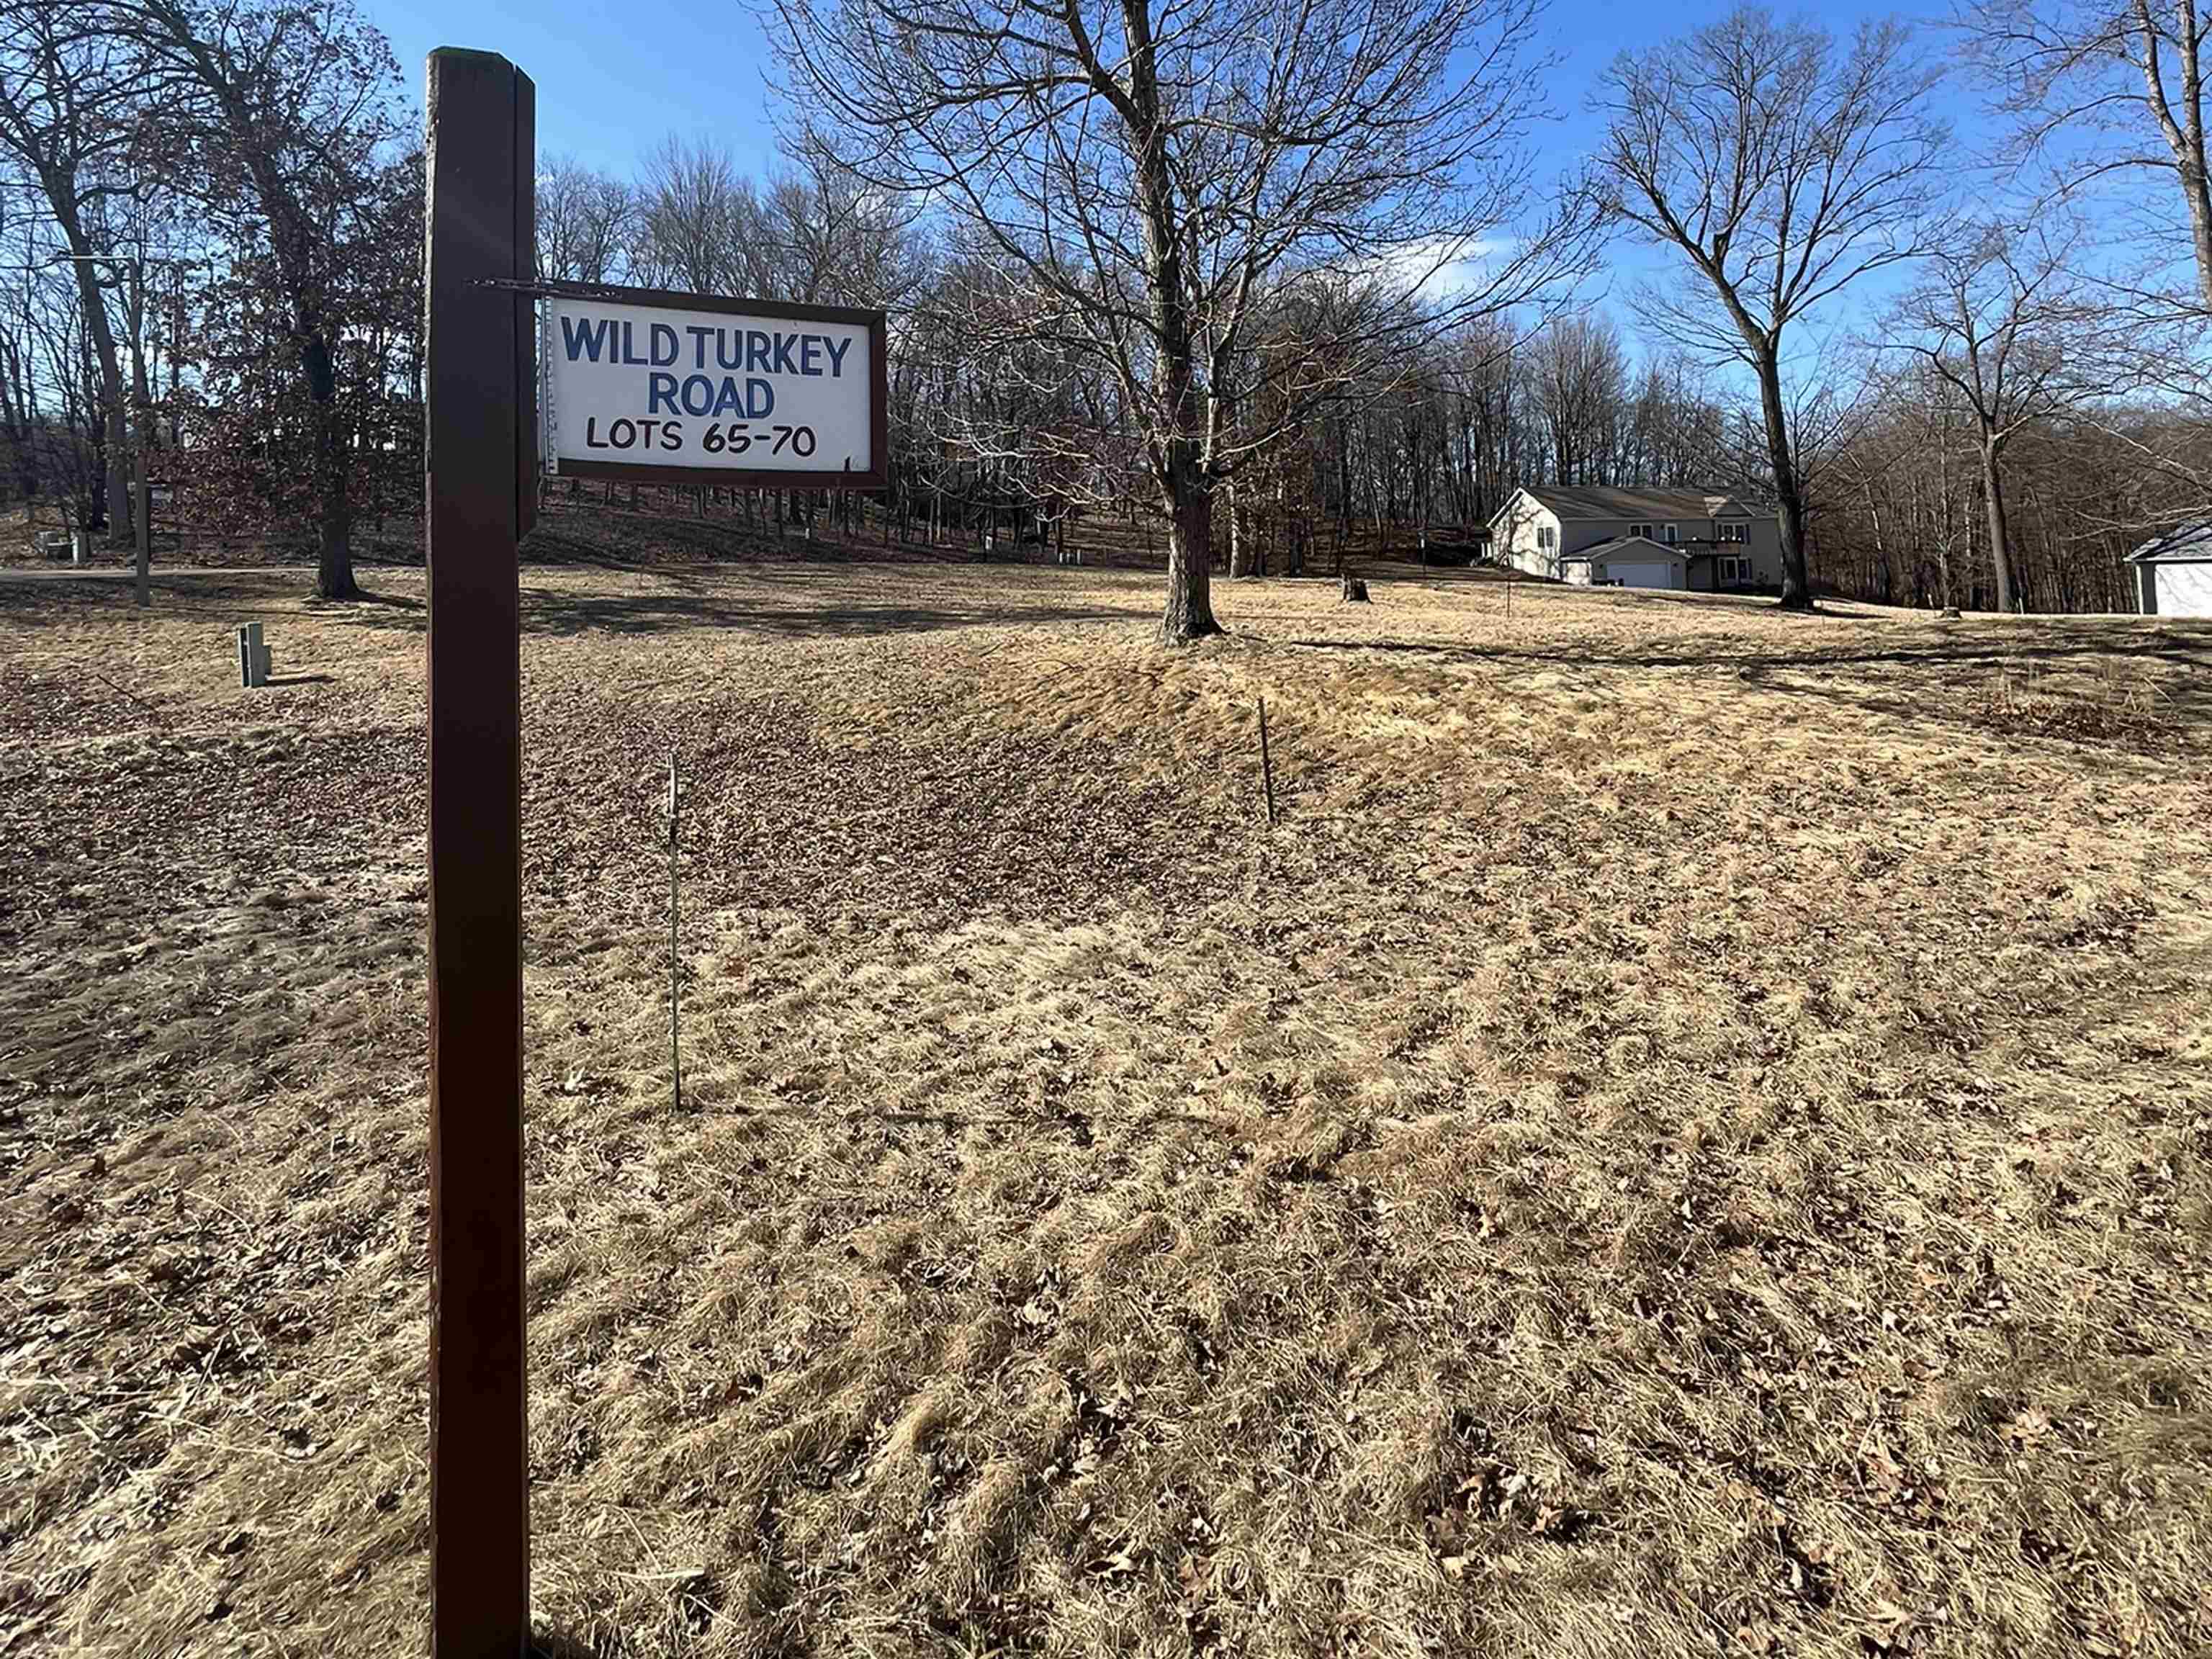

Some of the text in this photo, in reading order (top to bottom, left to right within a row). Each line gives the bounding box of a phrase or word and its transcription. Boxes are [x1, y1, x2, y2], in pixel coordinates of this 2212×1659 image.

[561, 316, 853, 377] WILD TURKEY
[648, 372, 775, 419] ROAD
[586, 417, 817, 457] LOTS 65-70
